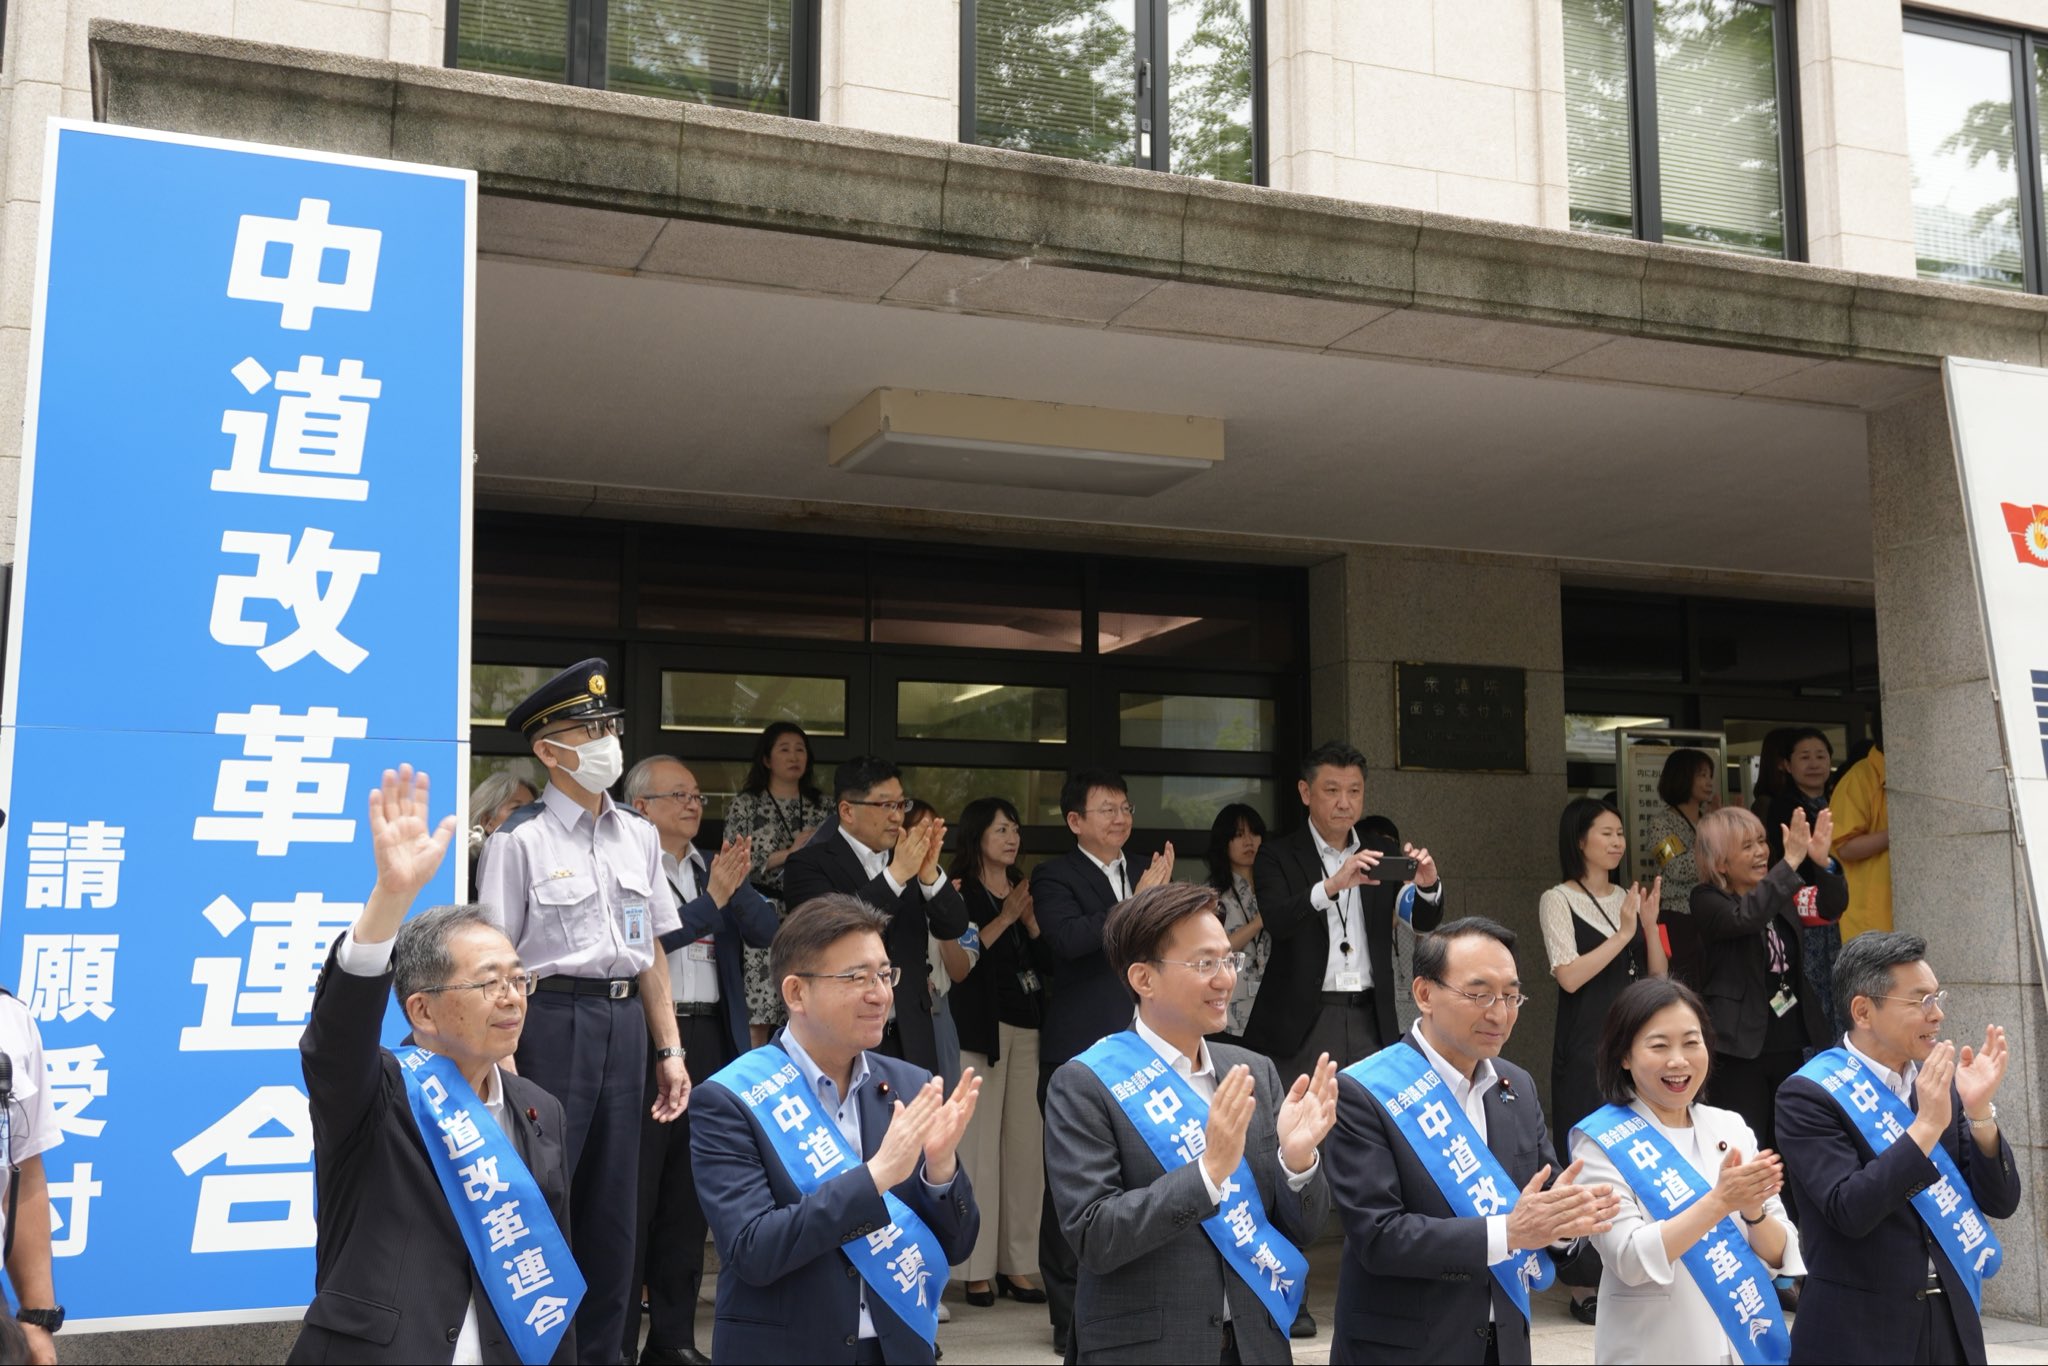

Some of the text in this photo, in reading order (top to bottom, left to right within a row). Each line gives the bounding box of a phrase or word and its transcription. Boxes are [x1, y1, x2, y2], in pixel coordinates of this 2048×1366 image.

[172, 198, 382, 1254] 中道改革連合
[421, 1074, 569, 1337] 中道改革連合
[1385, 1069, 1441, 1118] 国会議員団
